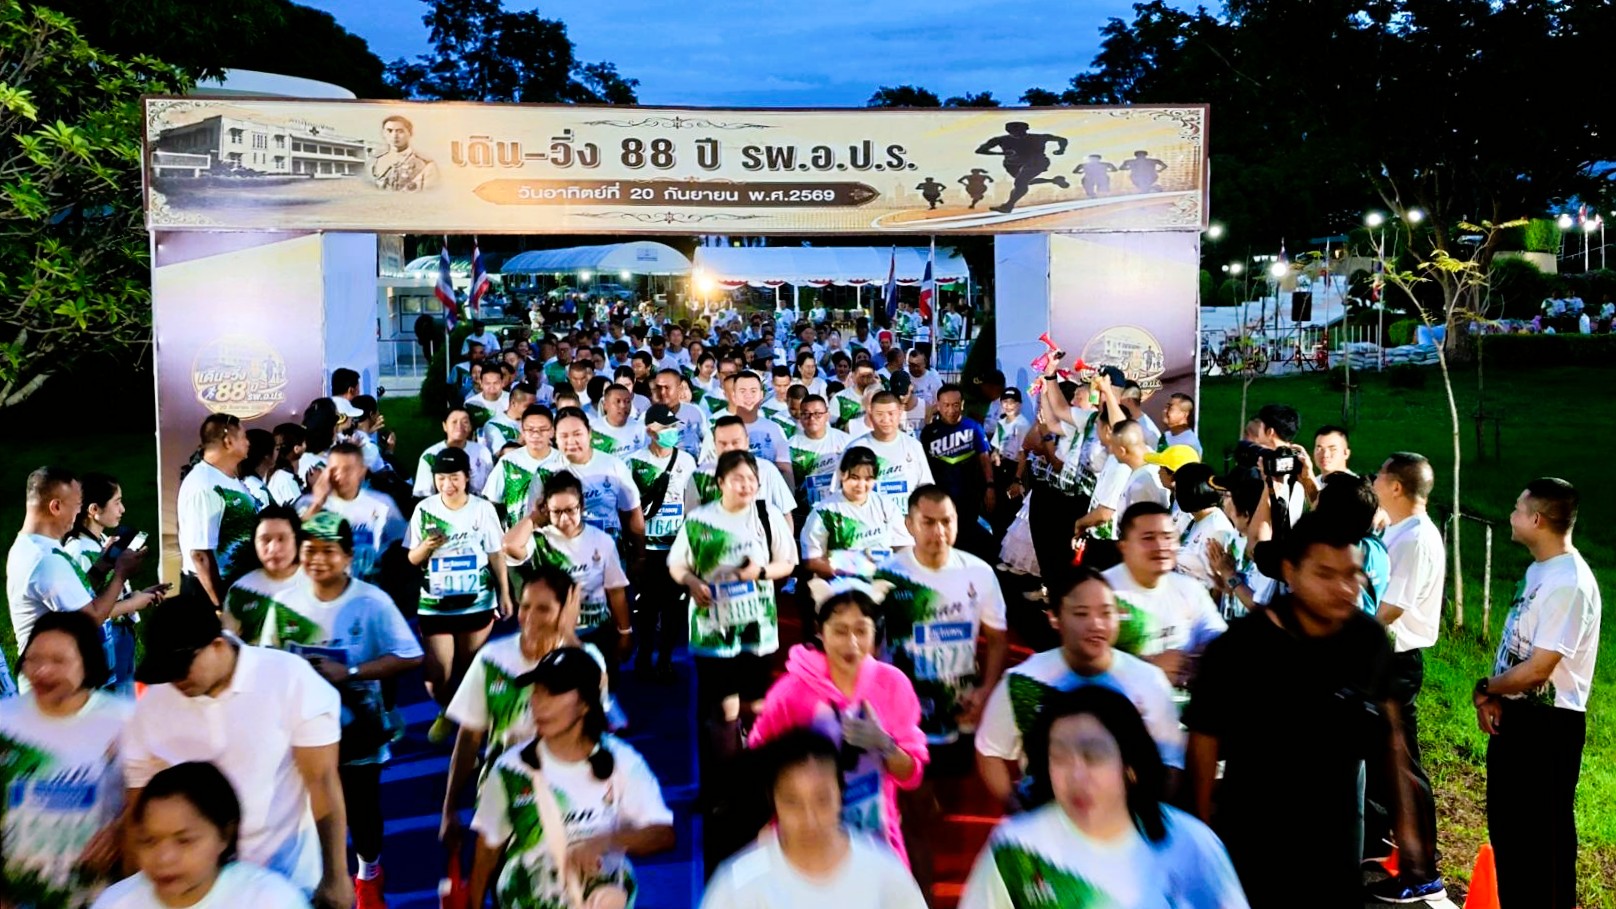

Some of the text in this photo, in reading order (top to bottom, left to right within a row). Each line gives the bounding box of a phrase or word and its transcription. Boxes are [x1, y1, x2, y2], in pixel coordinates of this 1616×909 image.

[620, 137, 677, 169] 88
[694, 137, 722, 170] ปี
[741, 139, 918, 171] รพ.อ.ป.ร.
[518, 182, 836, 202] วันอาทิตย์ที่ 20 กันยายน พ.ศ.2569
[215, 381, 247, 402] 88
[444, 574, 477, 593] 912
